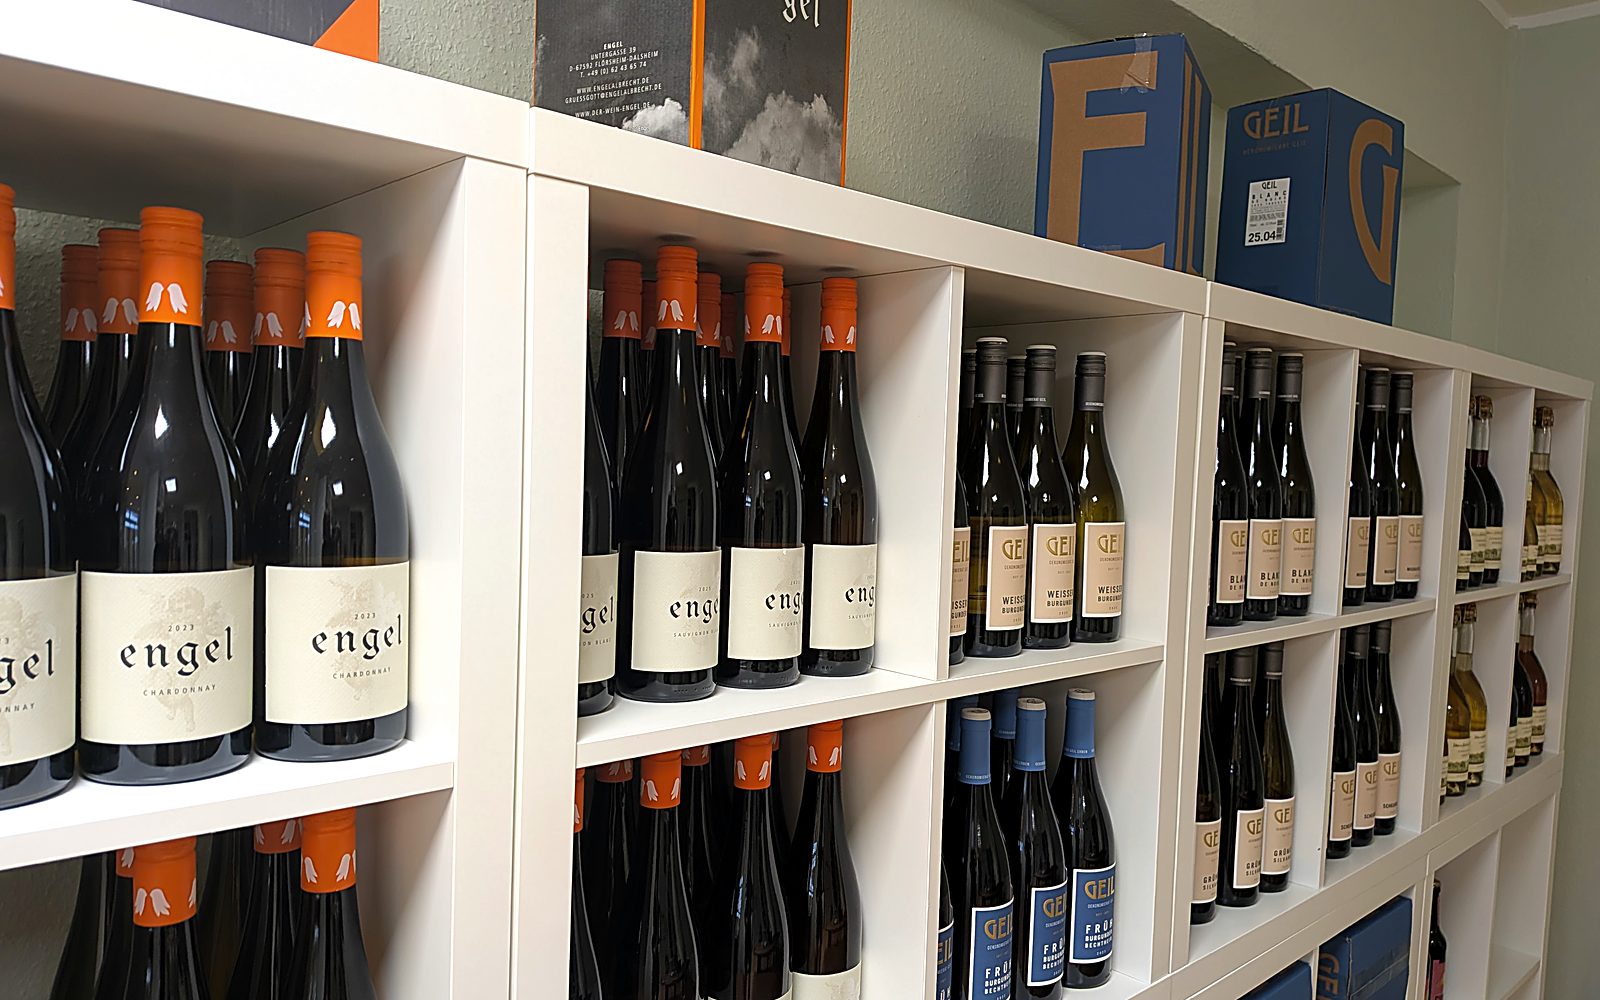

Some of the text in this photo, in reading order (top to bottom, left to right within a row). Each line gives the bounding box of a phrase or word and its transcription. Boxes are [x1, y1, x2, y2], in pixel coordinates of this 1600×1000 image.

[603, 41, 623, 50] ENGEL
[590, 46, 637, 61] UNTERGASSE 39
[569, 63, 593, 72] D-67592
[600, 67, 609, 76] (0)
[610, 65, 618, 73] 62
[620, 64, 628, 72] 43
[629, 62, 637, 70] 65
[639, 60, 647, 68] 74
[564, 83, 662, 104] GRUESSGOTT@ENGELALBRECHT.DE
[576, 77, 649, 95] WWW.ENGELALBRECHT.DE
[575, 101, 651, 118] WWW.DER-WEIN-ENGEL.DE
[1243, 103, 1309, 139] GEIL
[1262, 181, 1278, 190] GEIL
[1248, 231, 1276, 243] 25.04
[354, 612, 376, 620] 2023
[168, 624, 195, 632] 2023
[312, 614, 402, 660] engel
[120, 626, 233, 677] engel
[332, 667, 391, 680] CHARDONNAY
[143, 684, 217, 697] CHARDONNAY
[1084, 875, 1115, 900] GEIL
